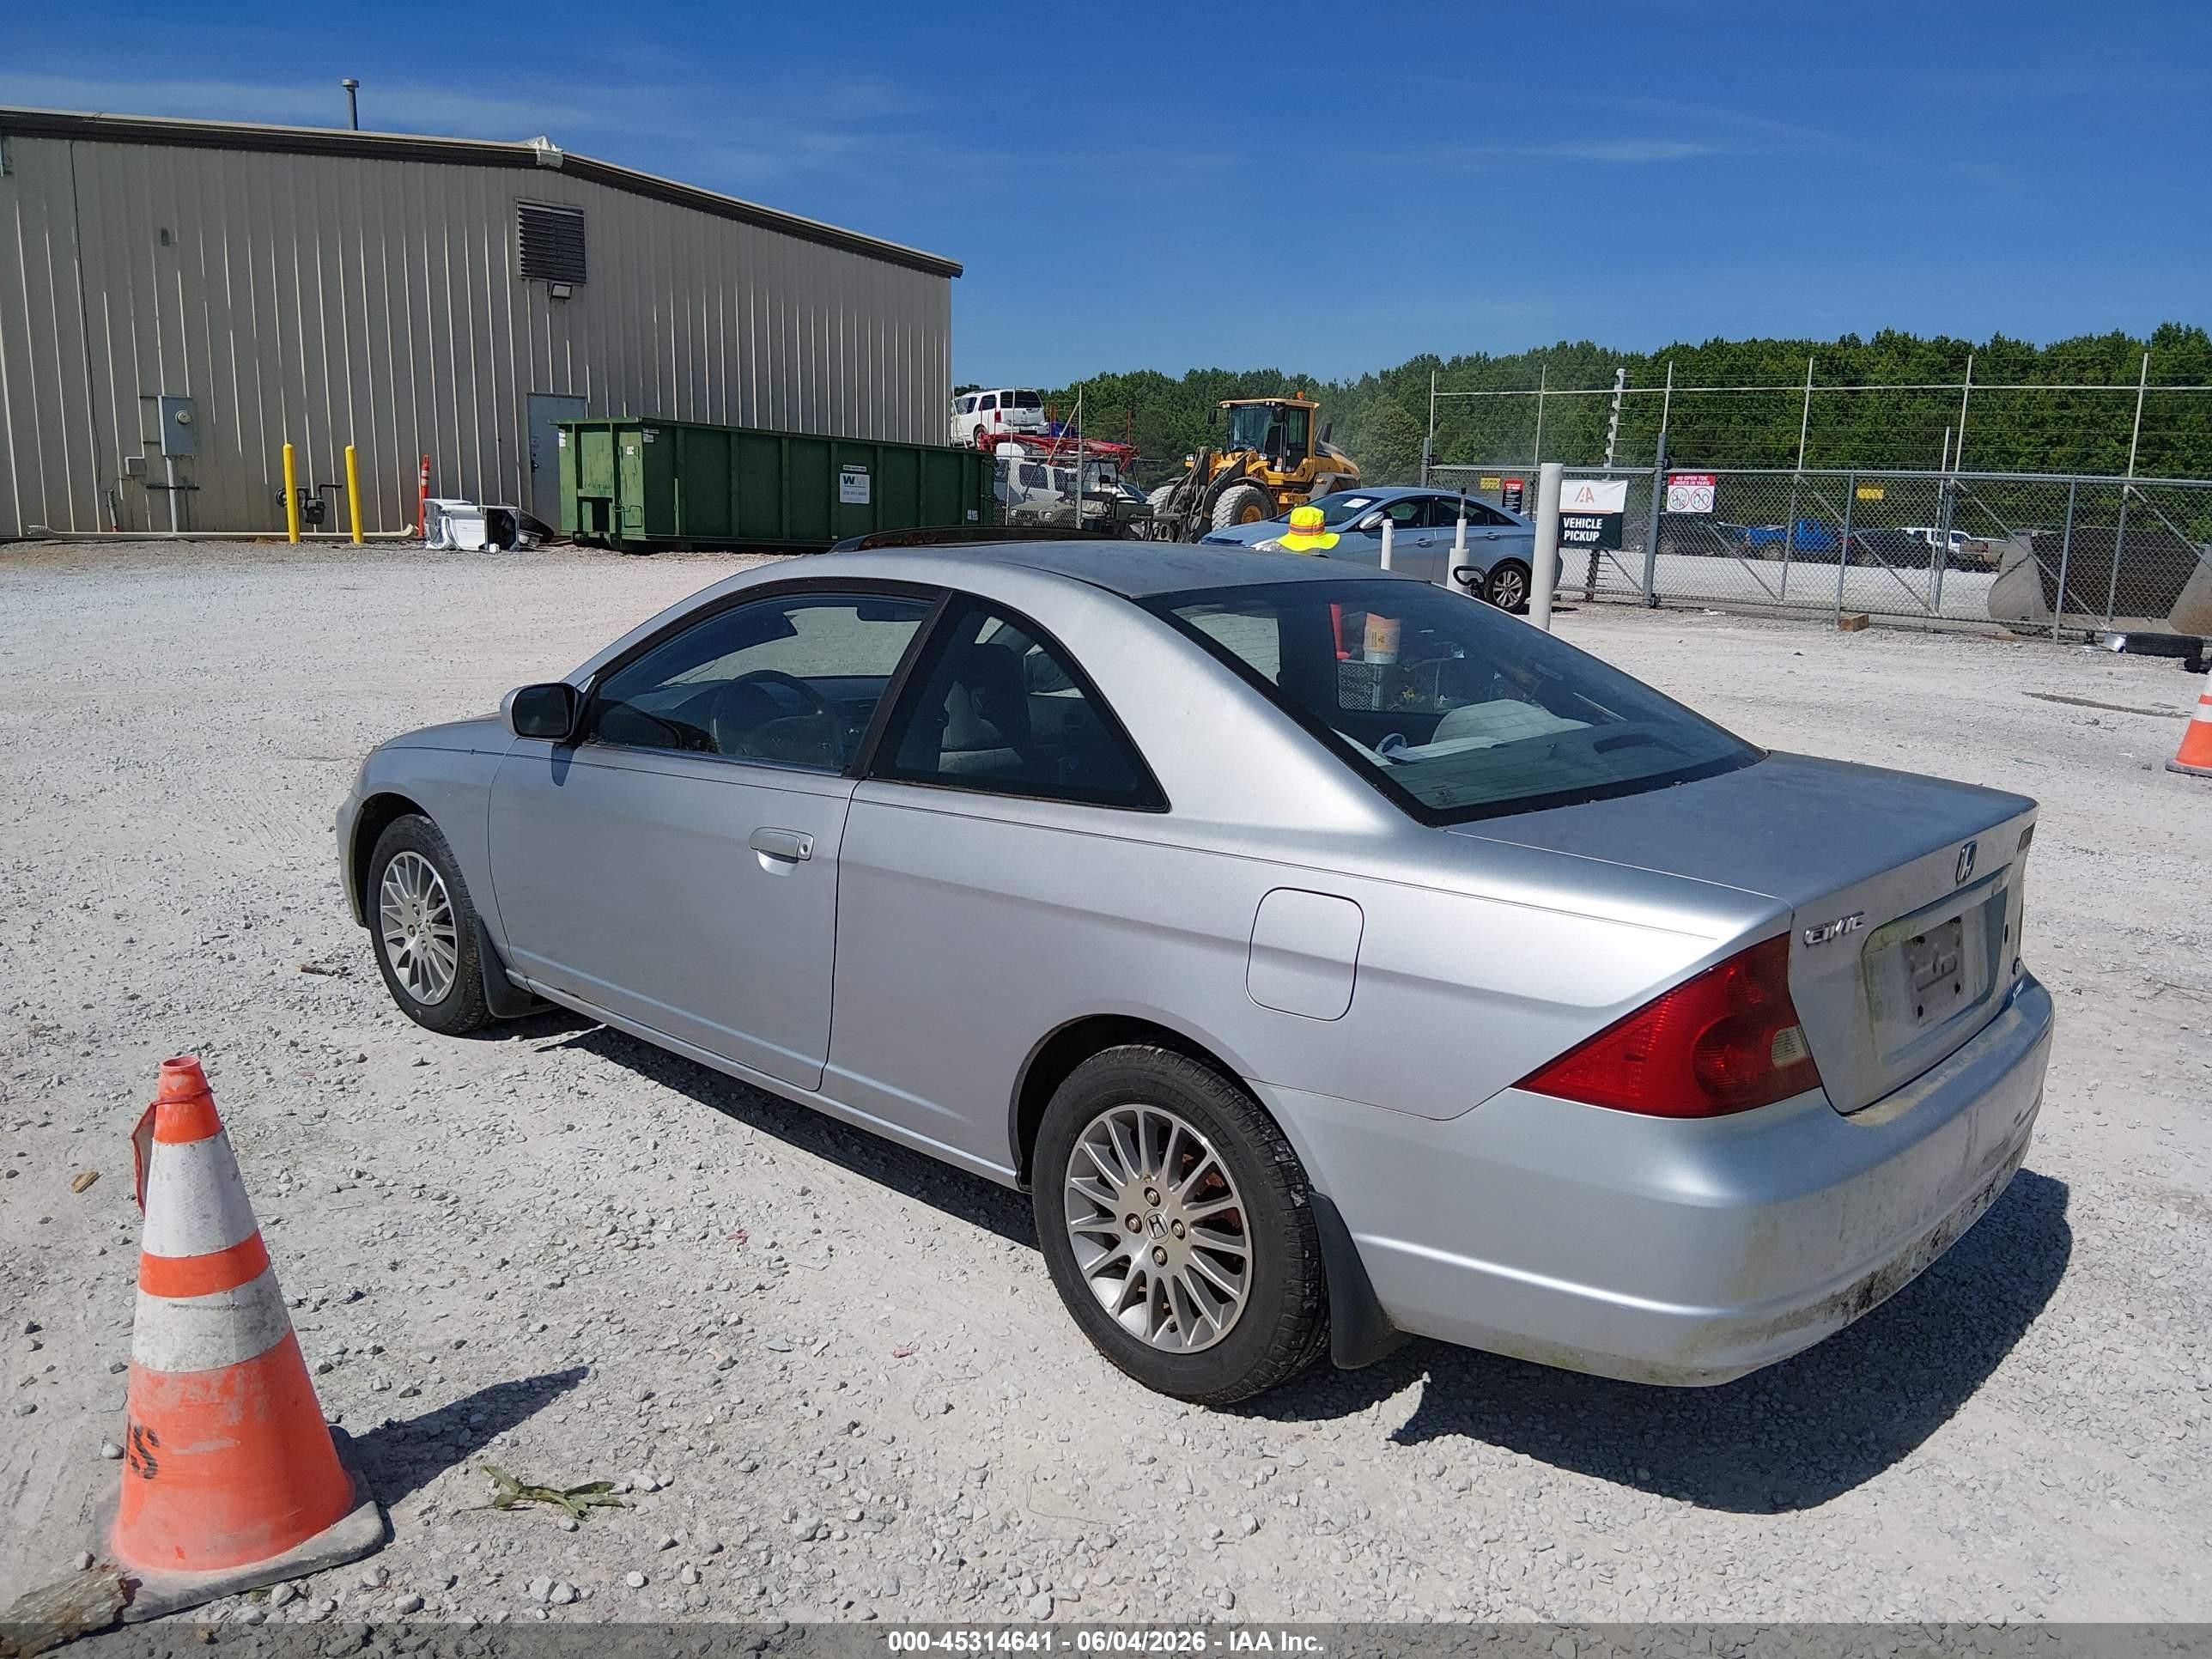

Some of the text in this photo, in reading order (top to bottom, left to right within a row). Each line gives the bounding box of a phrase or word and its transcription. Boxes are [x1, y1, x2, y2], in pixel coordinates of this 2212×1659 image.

[1563, 517, 1602, 530] VEHICLE
[1564, 530, 1600, 542] PICKUP
[1803, 911, 1865, 946] CIVIC
